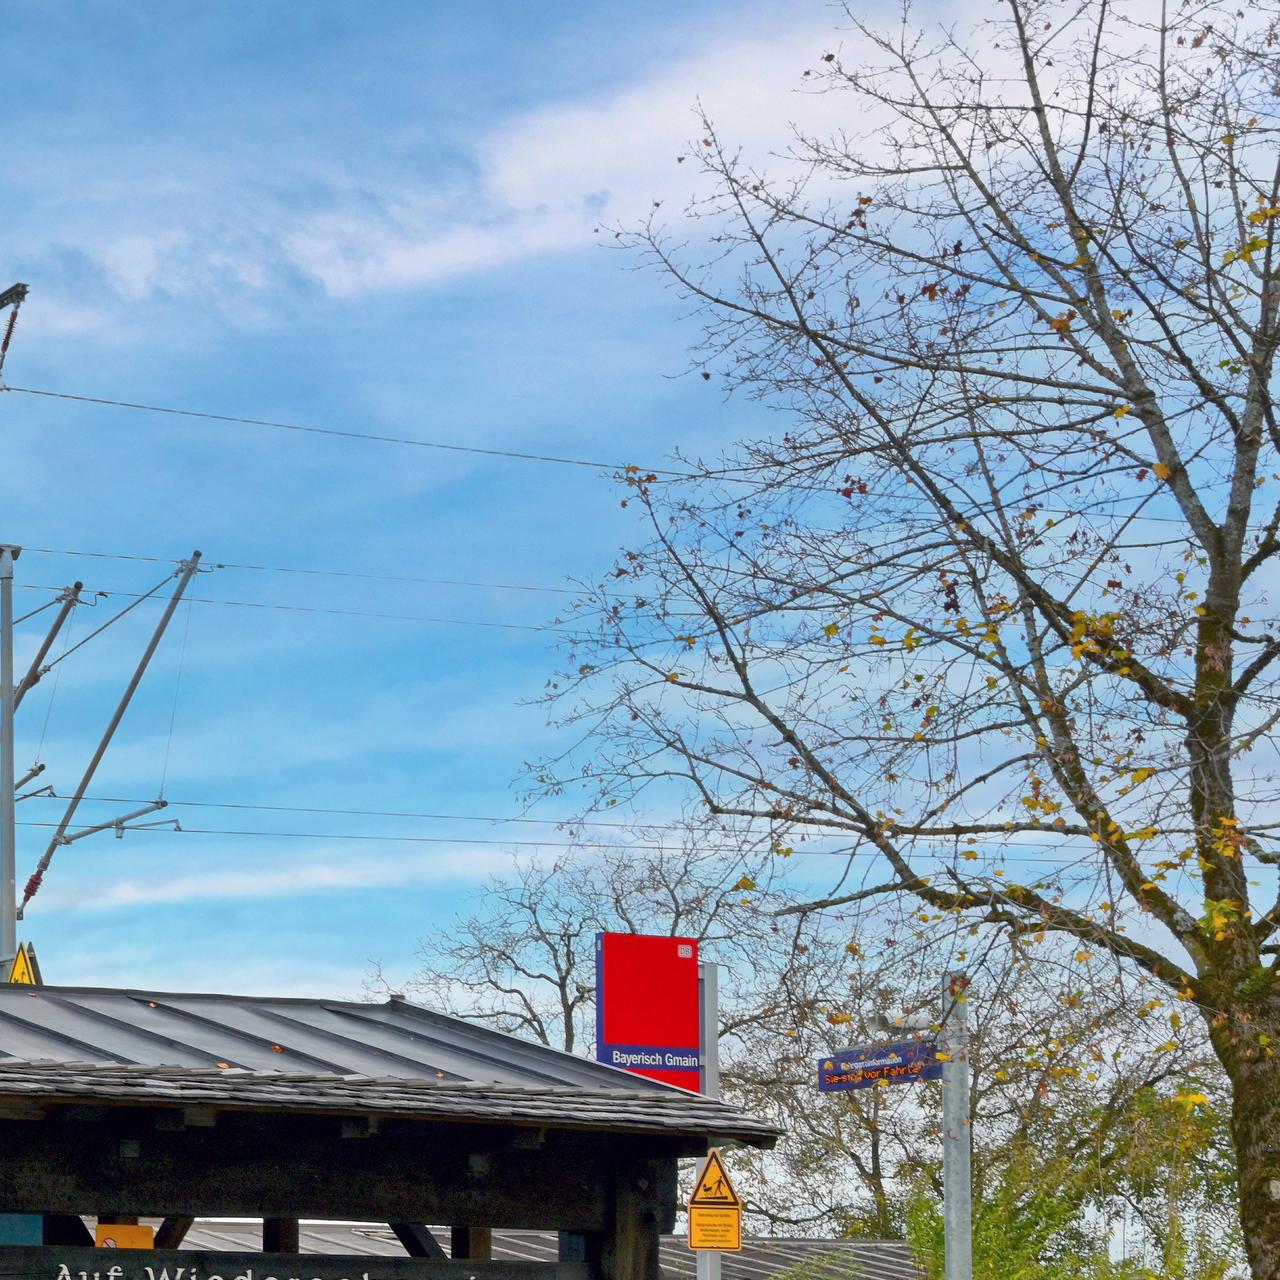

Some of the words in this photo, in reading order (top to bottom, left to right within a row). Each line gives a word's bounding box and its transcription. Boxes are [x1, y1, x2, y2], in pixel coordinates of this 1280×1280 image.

[612, 1050, 662, 1067] Bayerisch
[664, 1053, 698, 1067] Gmain
[864, 1067, 882, 1080] vor
